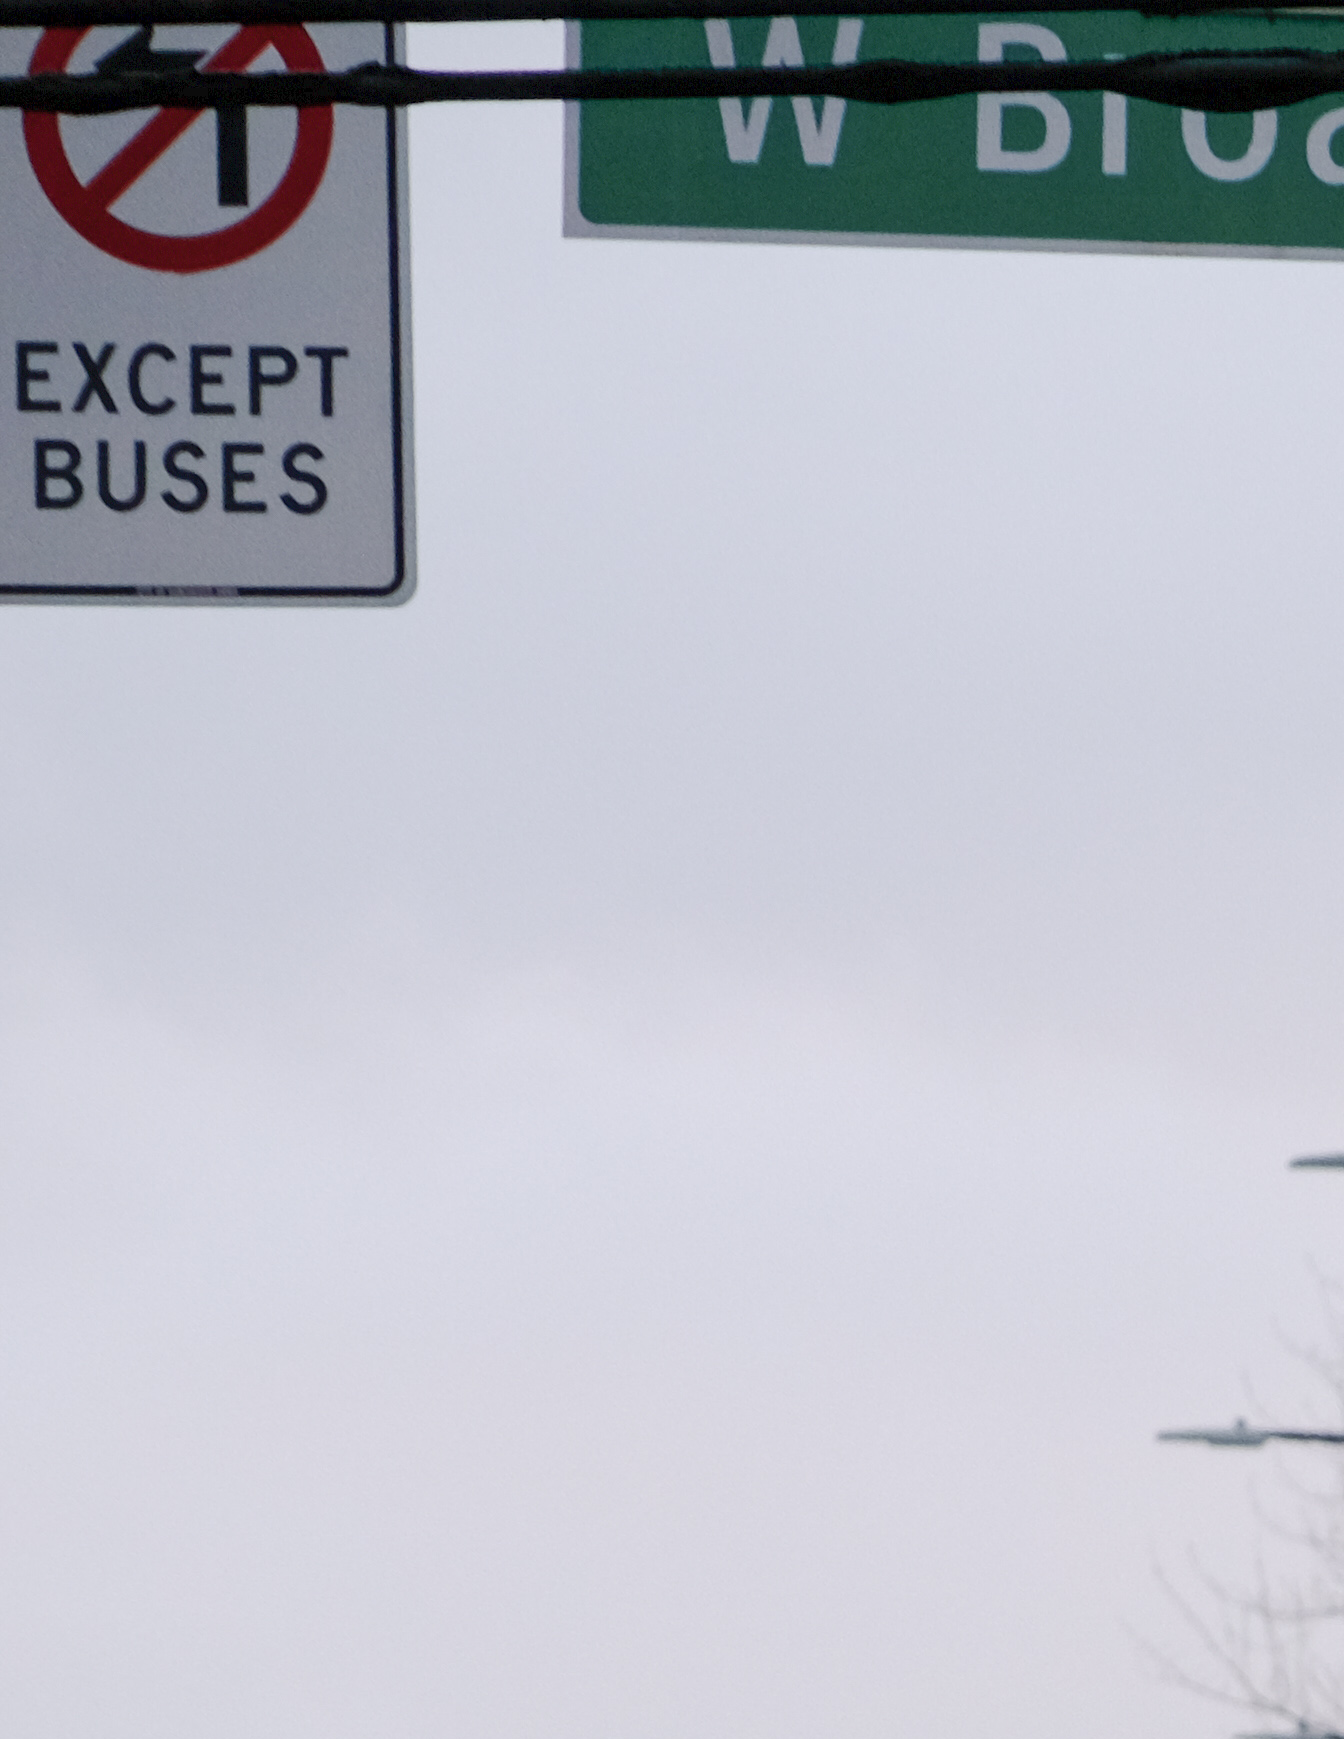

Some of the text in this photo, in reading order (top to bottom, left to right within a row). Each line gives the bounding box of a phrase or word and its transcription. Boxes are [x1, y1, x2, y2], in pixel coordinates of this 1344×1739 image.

[703, 17, 864, 166] W
[14, 341, 350, 418] EXCEPT
[33, 439, 330, 516] BUSES
